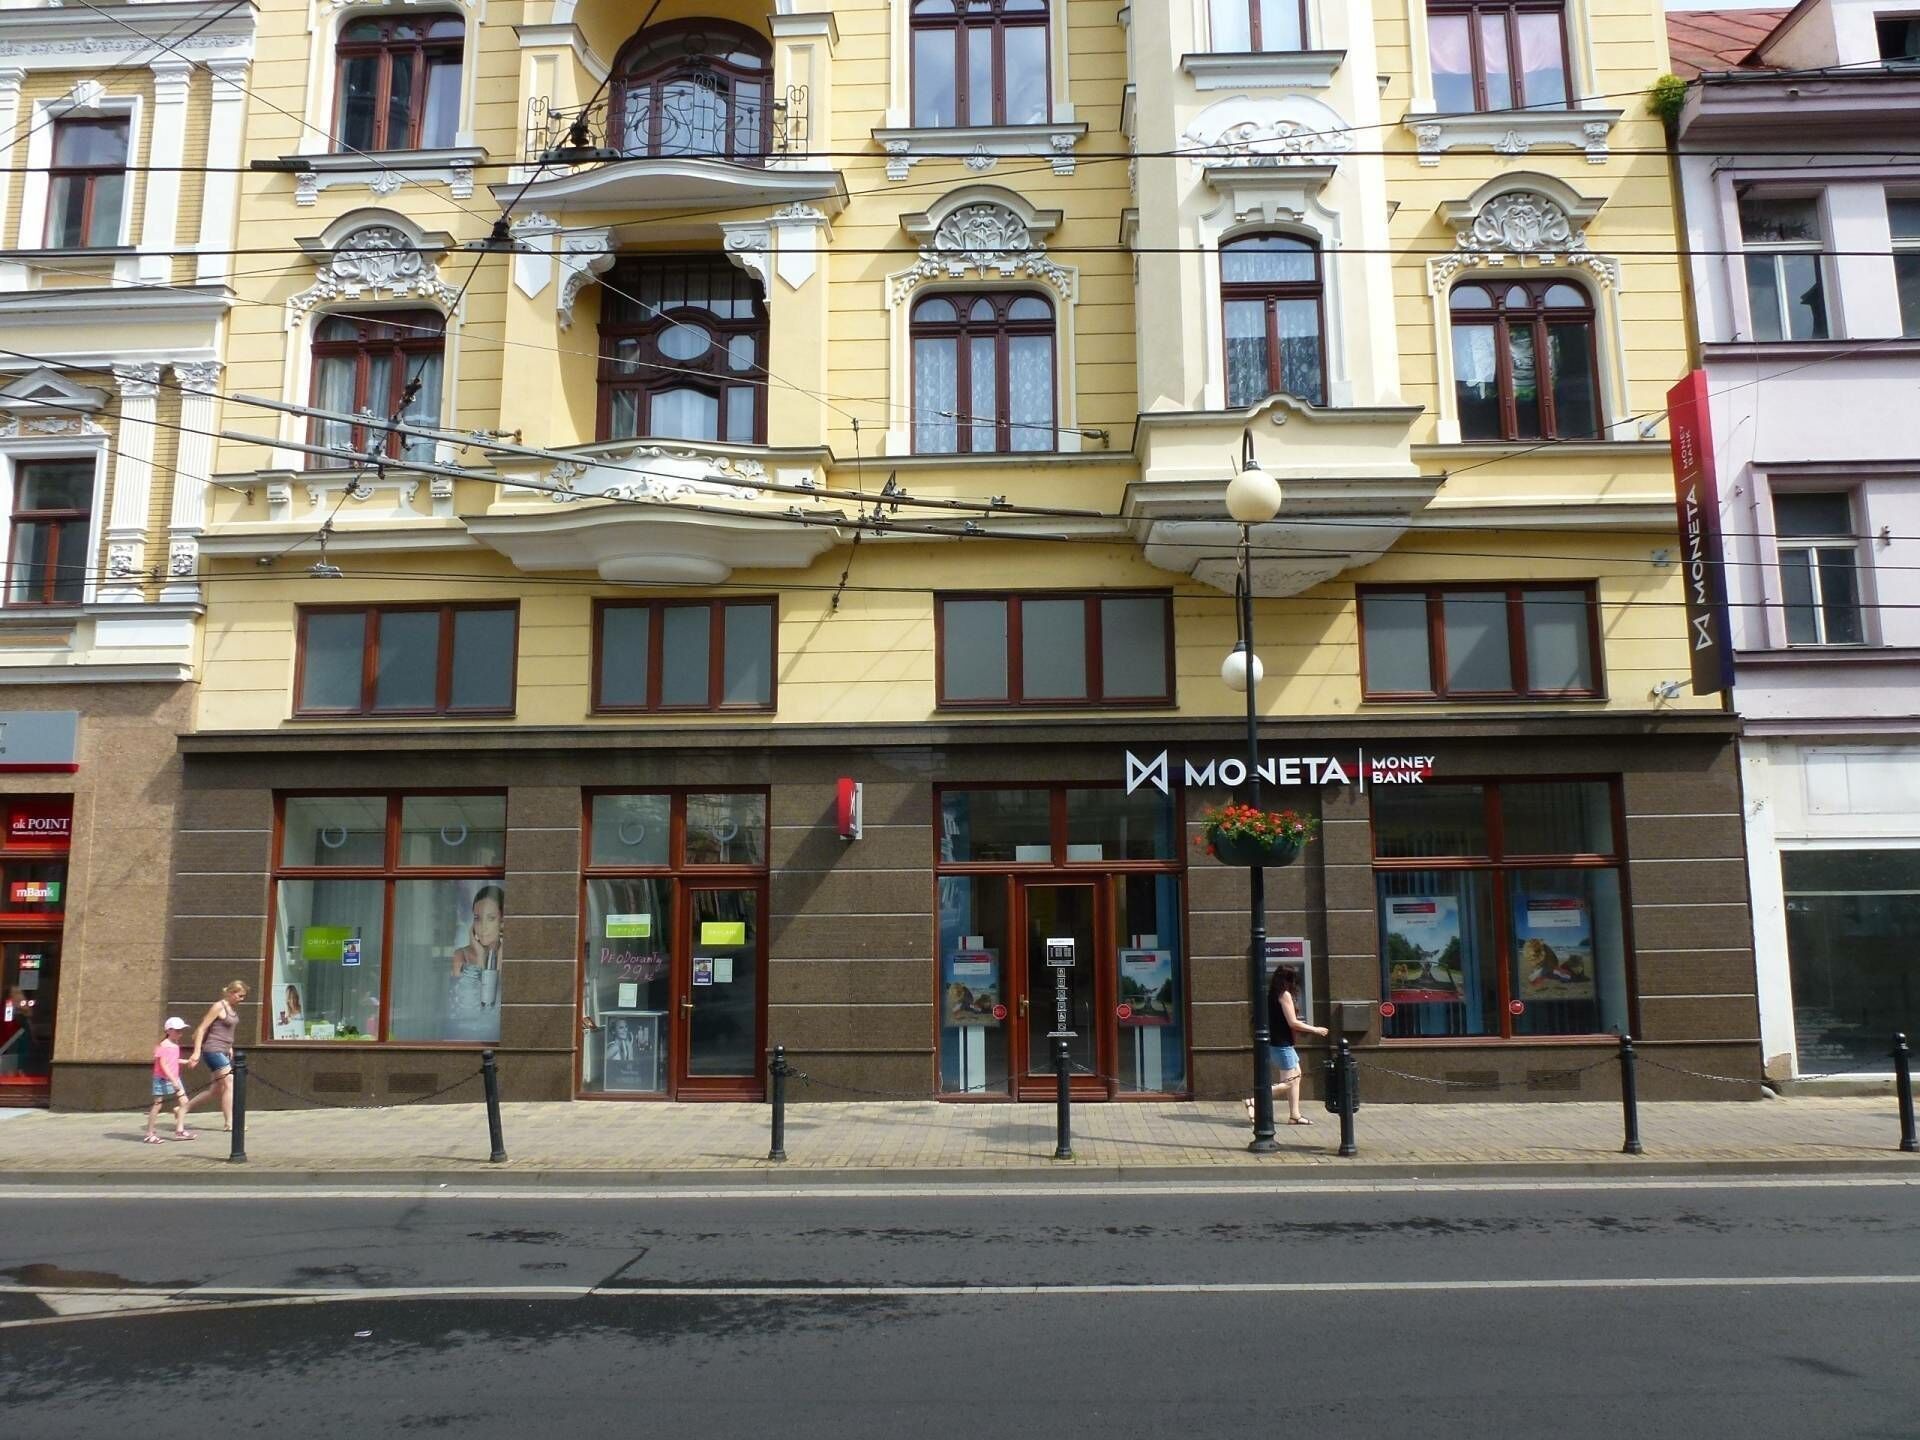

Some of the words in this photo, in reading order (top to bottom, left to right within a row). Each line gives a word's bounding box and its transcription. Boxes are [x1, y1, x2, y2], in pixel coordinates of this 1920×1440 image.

[1679, 425, 1688, 469] MONEY
[1685, 430, 1694, 466] BANK
[1686, 484, 1705, 604] MONETA
[1372, 756, 1435, 769] MONEY
[1185, 757, 1350, 786] MONETA
[1372, 771, 1424, 784] BANK
[12, 818, 26, 829] ok
[28, 818, 70, 829] POINT
[16, 888, 54, 897] mBank
[617, 964, 642, 981] 29
